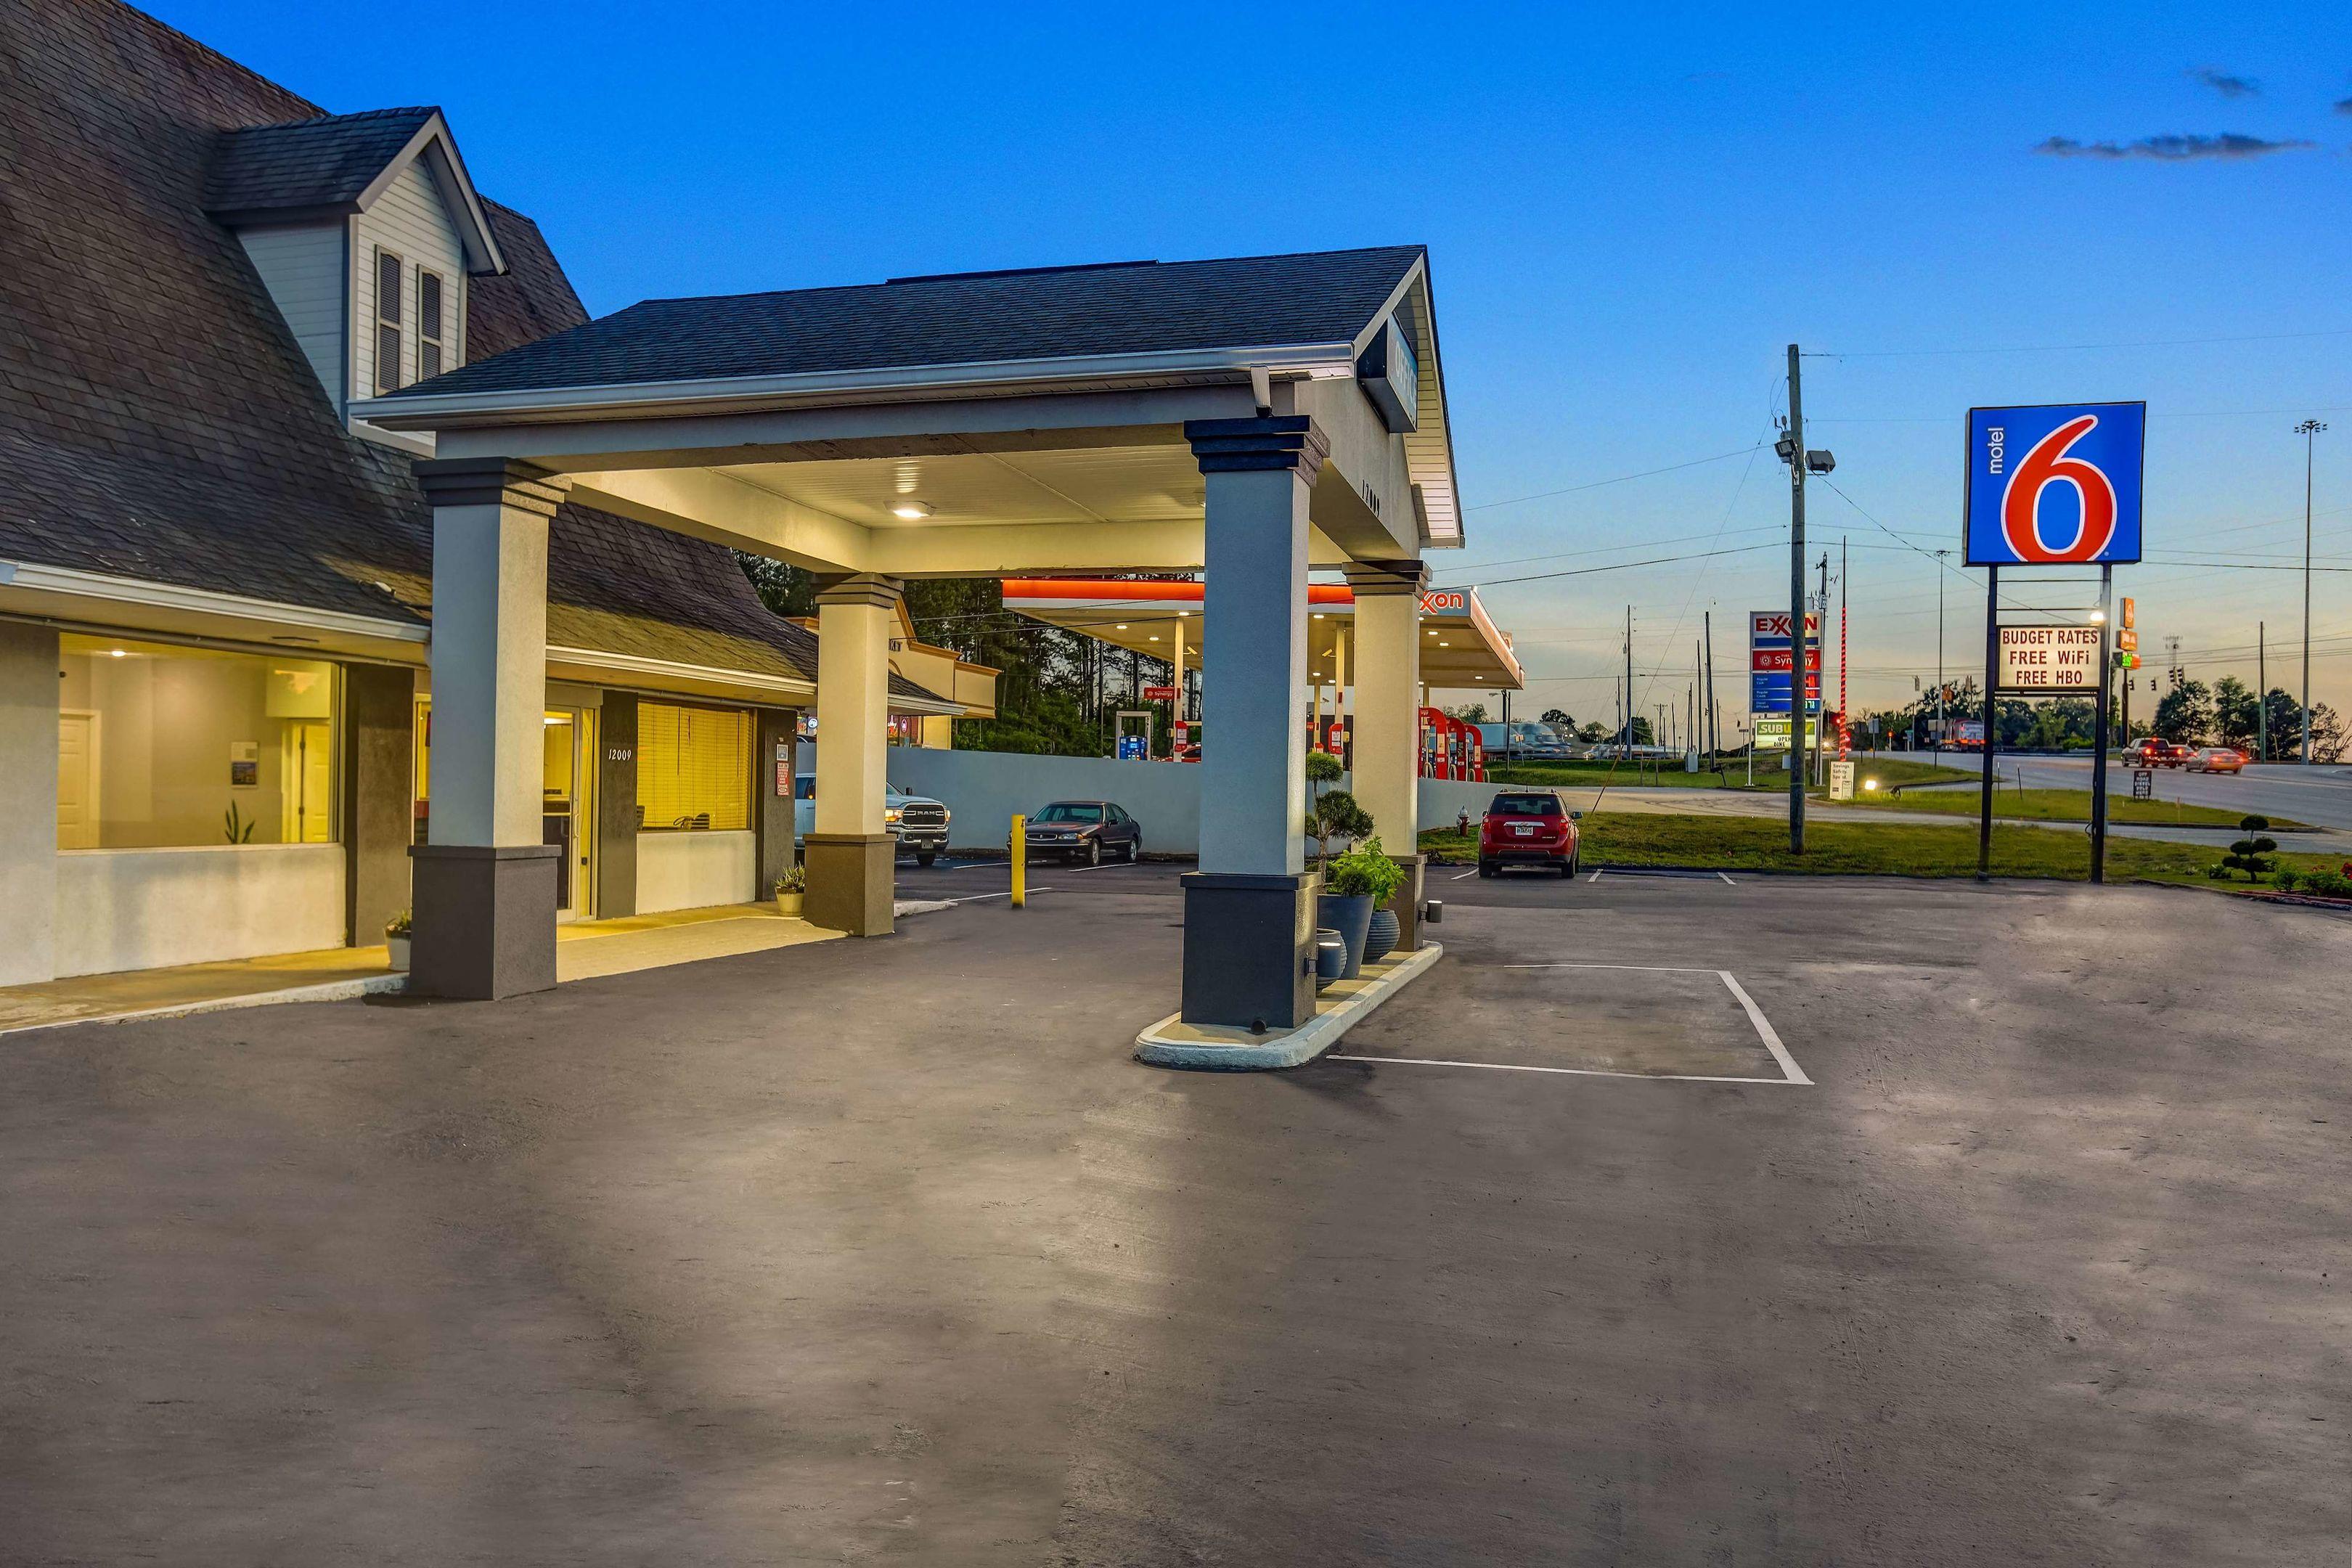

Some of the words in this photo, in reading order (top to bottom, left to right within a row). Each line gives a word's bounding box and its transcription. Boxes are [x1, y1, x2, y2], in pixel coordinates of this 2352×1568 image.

[1988, 427, 2004, 475] motel
[2001, 414, 2118, 562] 6
[1362, 479, 1380, 518] 12009
[1755, 616, 1818, 637] EXXN
[2002, 630, 2053, 645] BUDGET
[2057, 629, 2099, 645] RATES
[2009, 650, 2048, 665] FREE
[2058, 650, 2090, 664] WiFi
[2015, 671, 2048, 685] FREE
[2056, 670, 2083, 685] HBO
[608, 748, 632, 761] 12009
